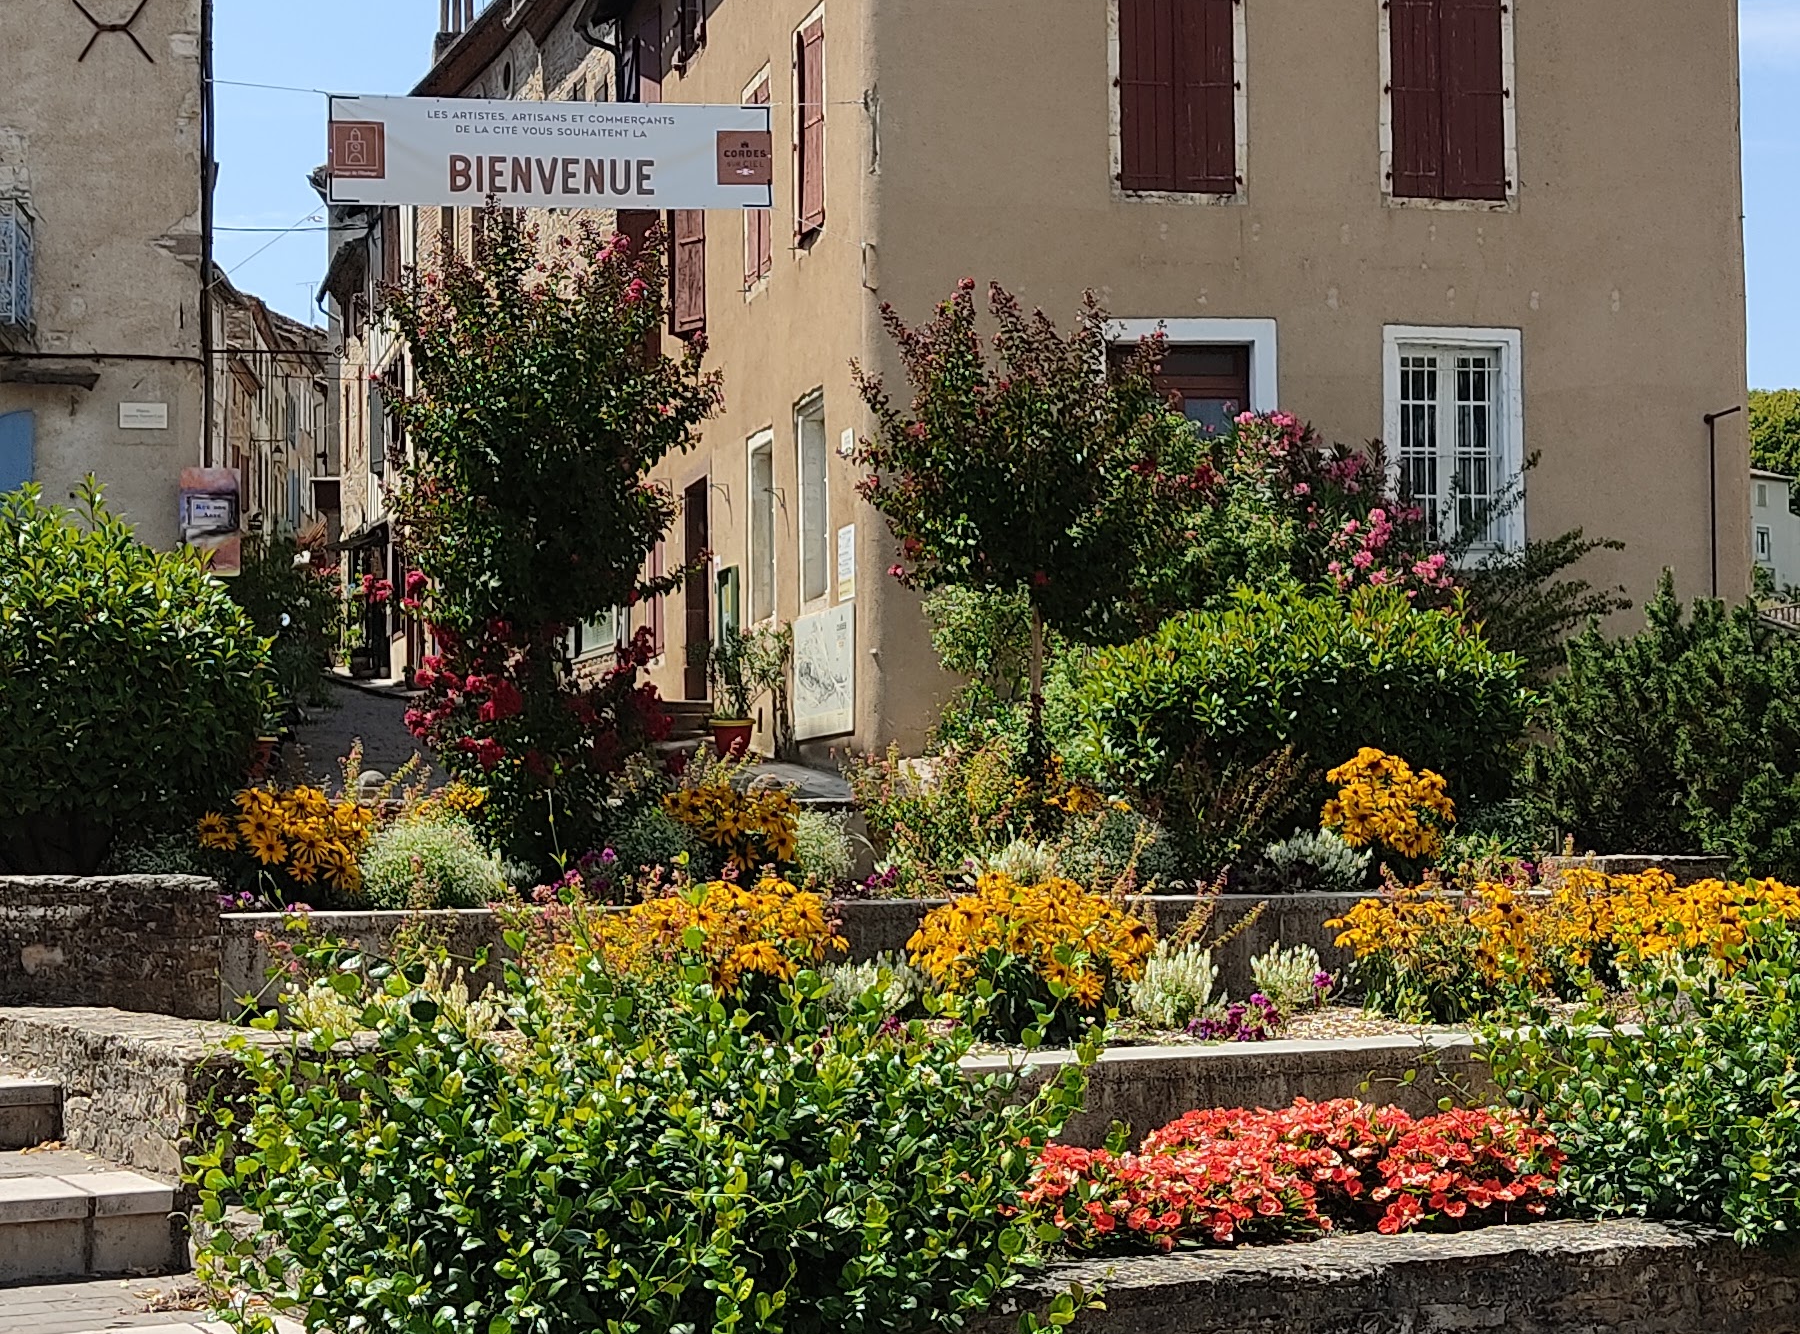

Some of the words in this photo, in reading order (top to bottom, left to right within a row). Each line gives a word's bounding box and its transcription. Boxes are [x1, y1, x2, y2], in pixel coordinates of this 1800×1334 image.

[427, 110, 448, 119] LES
[452, 111, 508, 122] ARTISTES,
[511, 113, 567, 123] ARTISANS
[571, 114, 584, 123] ET
[588, 114, 675, 126] COMMERÇANTS
[455, 124, 470, 134] DE
[474, 125, 489, 134] LA
[493, 125, 518, 135] CITÉ
[522, 126, 553, 136] VOUS
[557, 127, 629, 138] SOUHAITENT
[633, 129, 648, 138] LA
[723, 149, 767, 158] CORDES
[743, 160, 764, 168] CIEL
[449, 154, 655, 195] BIENVENUE
